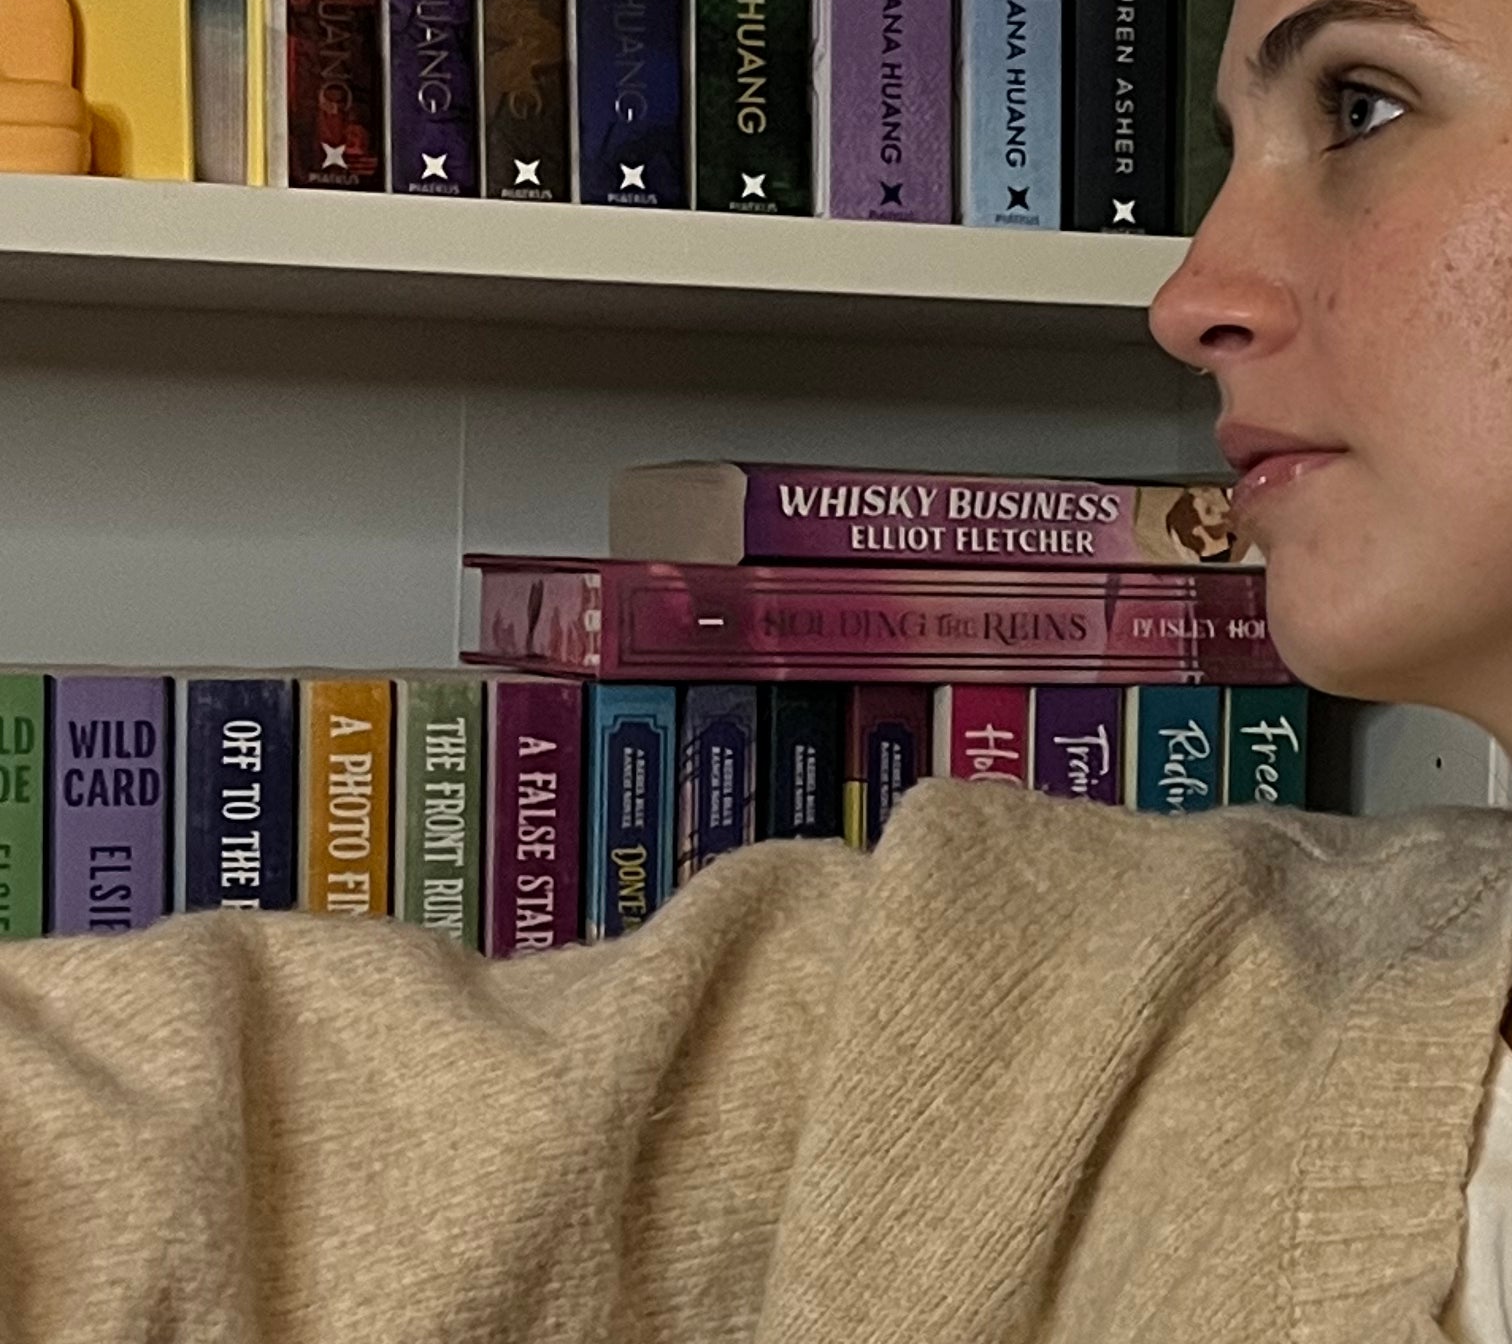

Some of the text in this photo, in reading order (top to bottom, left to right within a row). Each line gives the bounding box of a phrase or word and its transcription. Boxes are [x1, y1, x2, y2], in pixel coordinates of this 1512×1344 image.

[880, 60, 904, 166] HUANG
[1006, 0, 1026, 169] ANA HUANG
[1115, 77, 1135, 176] ASHER
[779, 483, 1121, 524] WHISKY BUSINESS
[850, 523, 1096, 556] ELLIOT FLETCHER
[982, 610, 1089, 648] REINS
[63, 767, 160, 808] CARD
[68, 720, 157, 759] WILD
[328, 714, 373, 860] A PHOTO
[220, 720, 262, 889] OFF TO THE
[424, 717, 466, 869] THE FRONT
[516, 735, 557, 862] A FALSE
